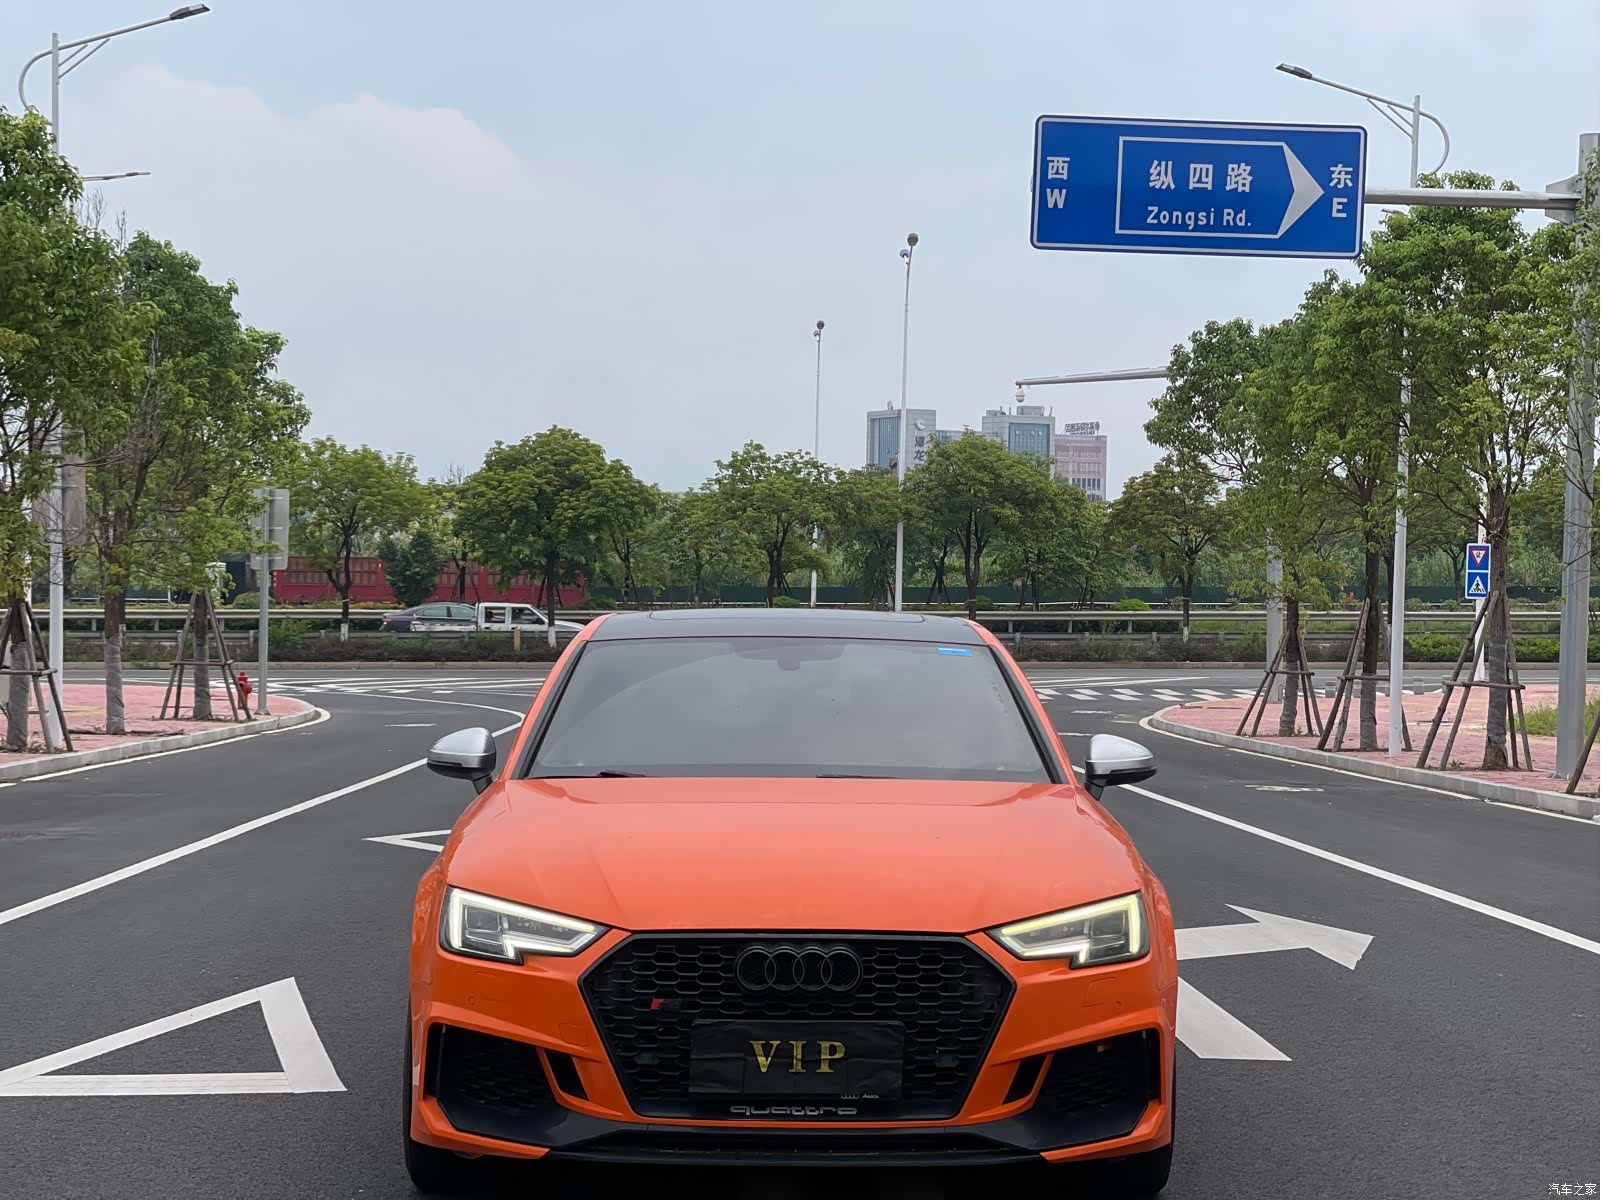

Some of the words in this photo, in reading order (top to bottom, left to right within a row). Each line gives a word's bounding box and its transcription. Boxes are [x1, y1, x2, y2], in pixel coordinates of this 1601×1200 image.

[1047, 156, 1070, 180] 西
[1149, 160, 1253, 192] 纵四路
[1329, 163, 1353, 189] 东
[1046, 188, 1067, 209] W
[1331, 197, 1348, 218] E
[1146, 206, 1215, 230] Zongsi
[1223, 208, 1252, 227] Rd.
[749, 1040, 847, 1073] VIP
[730, 1105, 858, 1116] quattro
